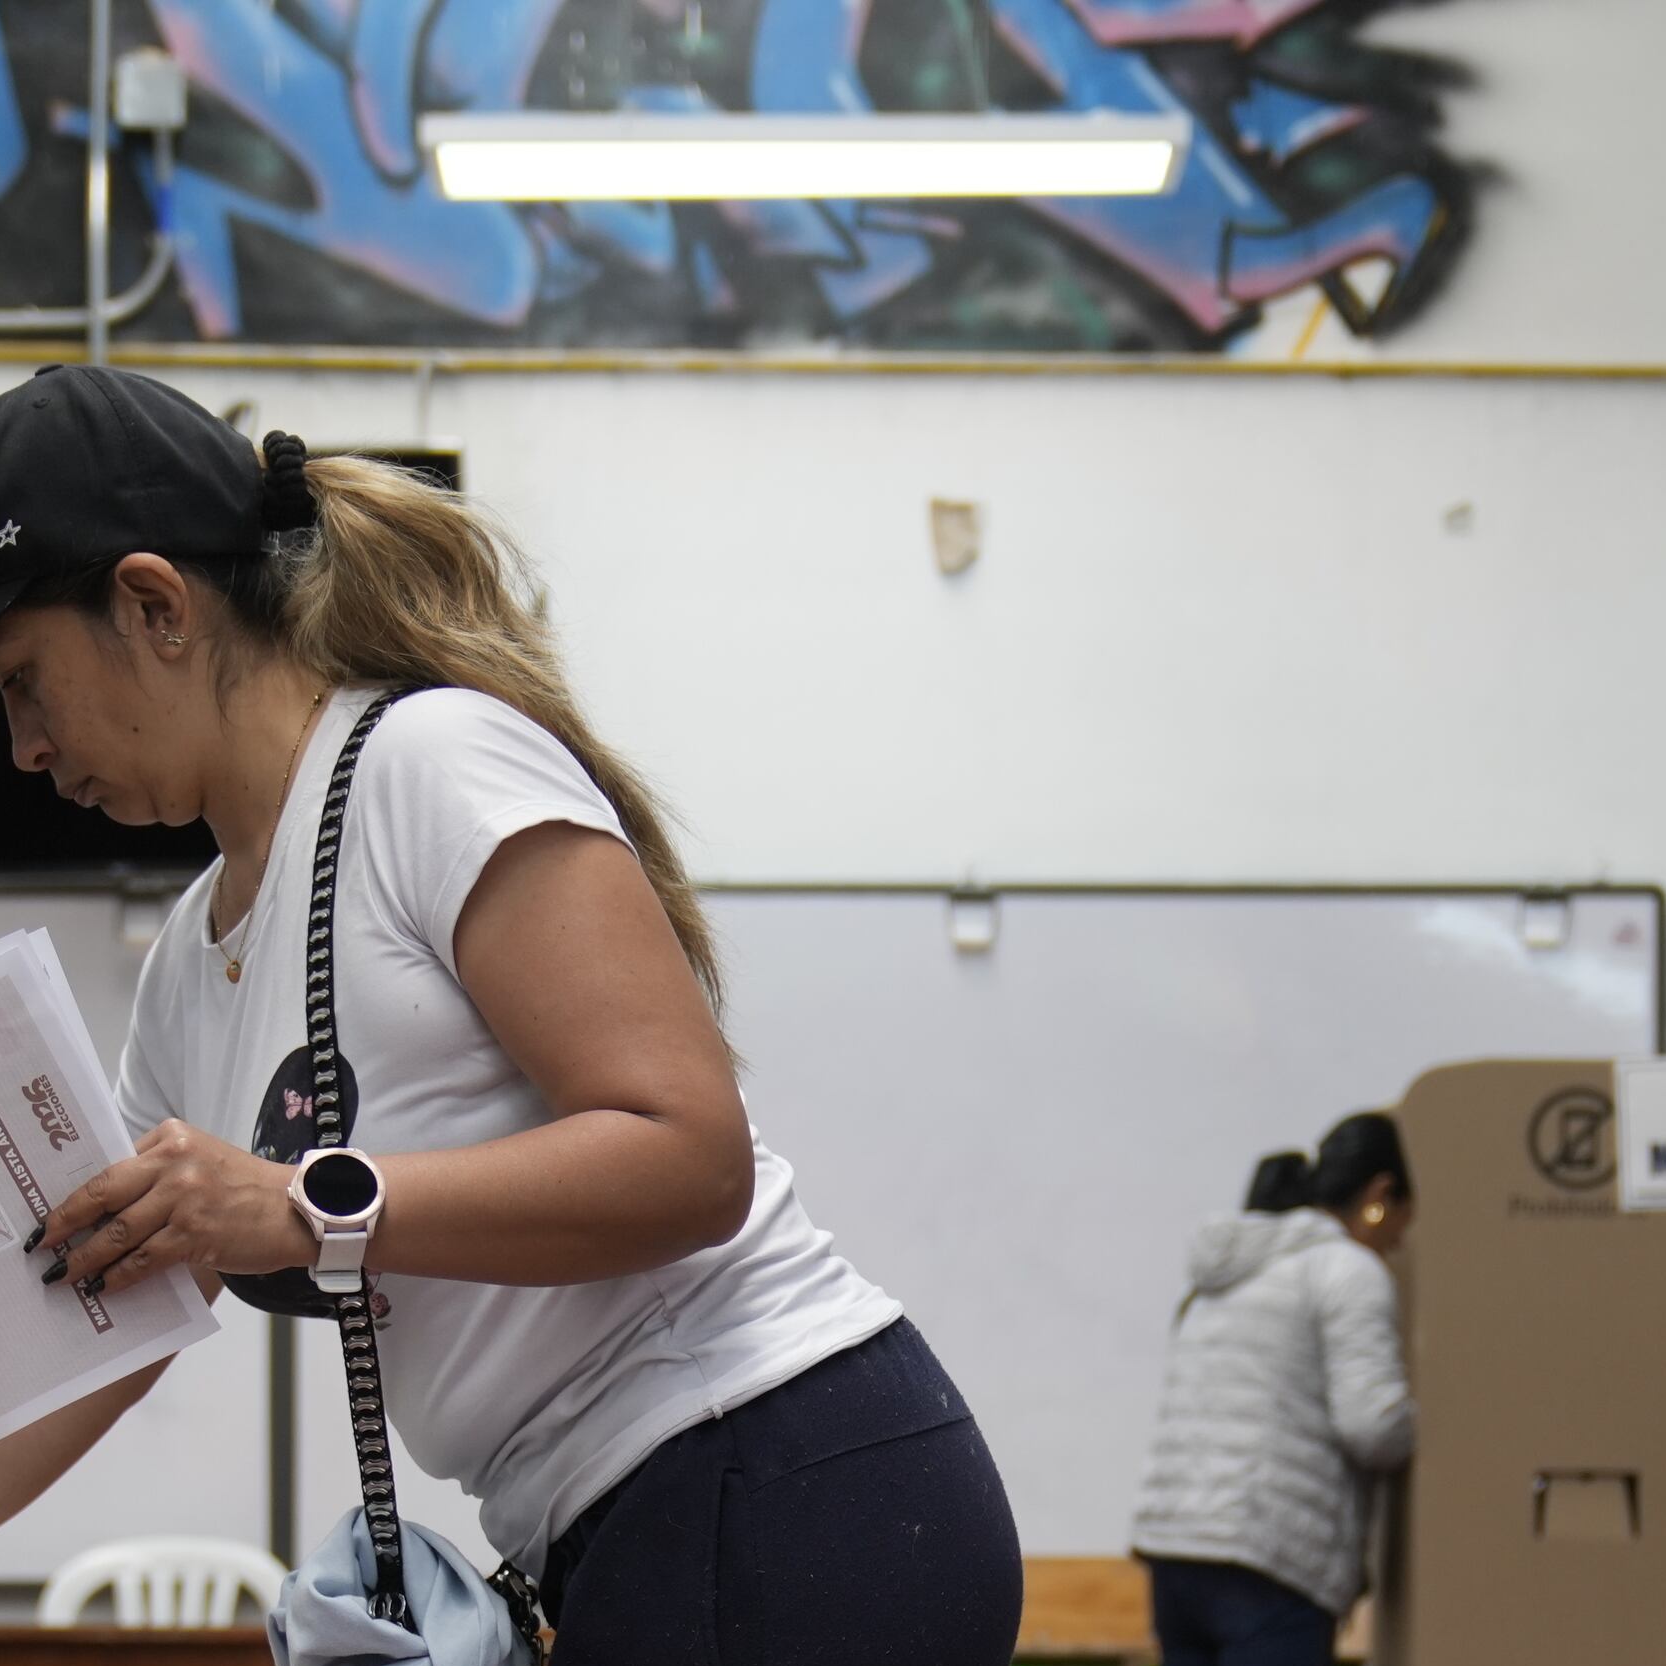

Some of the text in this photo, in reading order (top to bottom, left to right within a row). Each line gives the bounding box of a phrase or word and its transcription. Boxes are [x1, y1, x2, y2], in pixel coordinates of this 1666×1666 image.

[20, 1078, 72, 1152] 2026
[38, 1074, 80, 1141] ELECCIONES
[2, 1147, 32, 1187] LISTA
[23, 1184, 49, 1218] UNA
